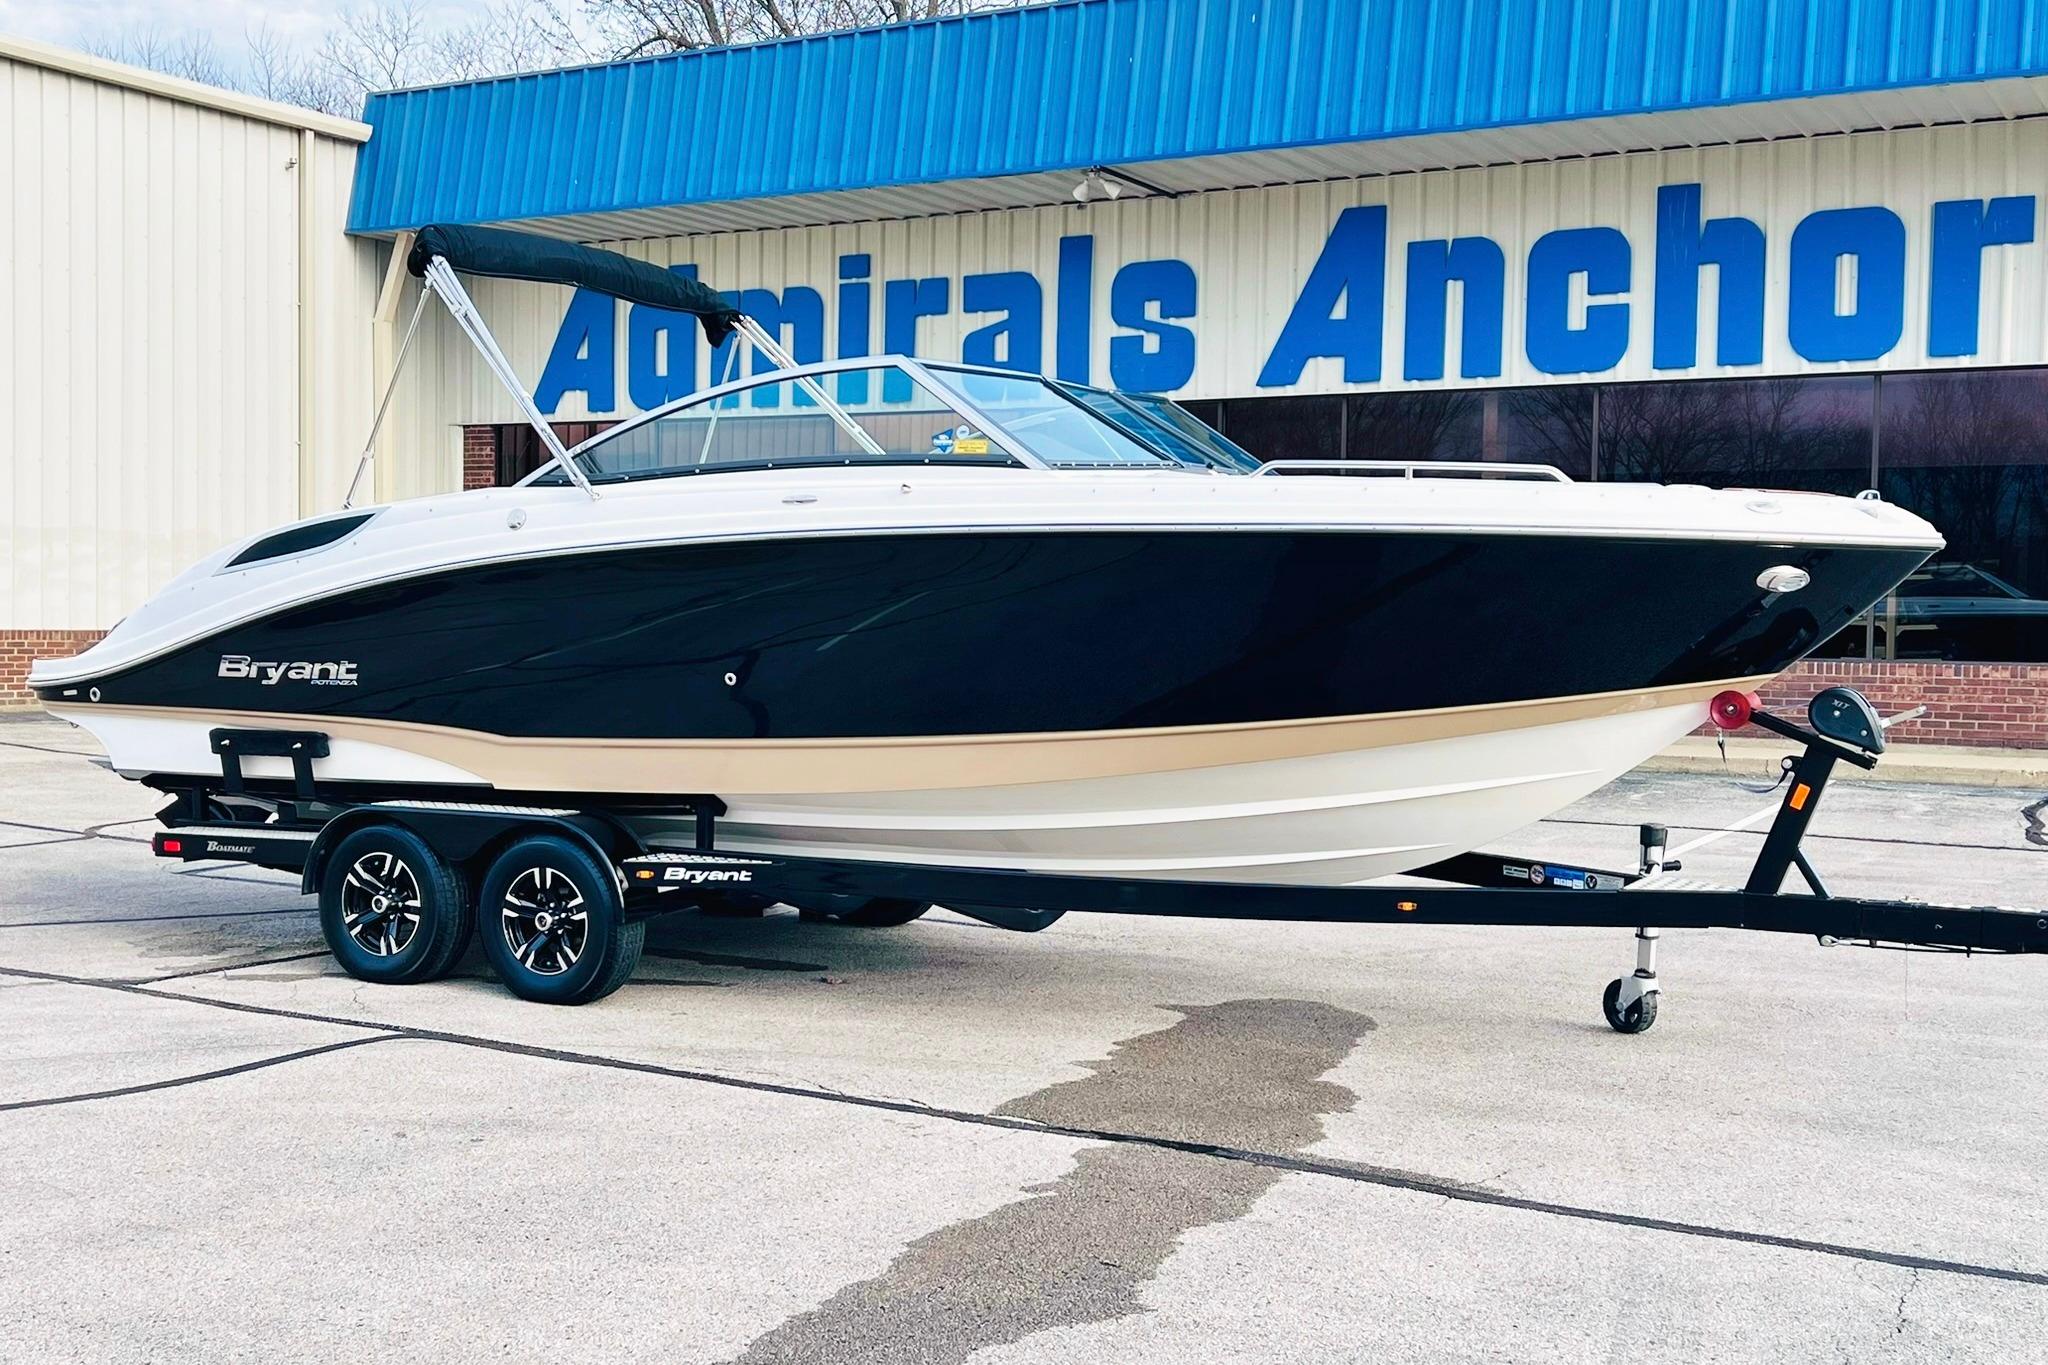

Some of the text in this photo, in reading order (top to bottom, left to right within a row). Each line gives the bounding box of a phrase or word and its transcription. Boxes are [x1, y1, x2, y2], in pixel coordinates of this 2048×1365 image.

[533, 183, 2036, 414] Admirals Anchor
[218, 654, 358, 685] Bryant
[663, 867, 752, 883] Bryant
